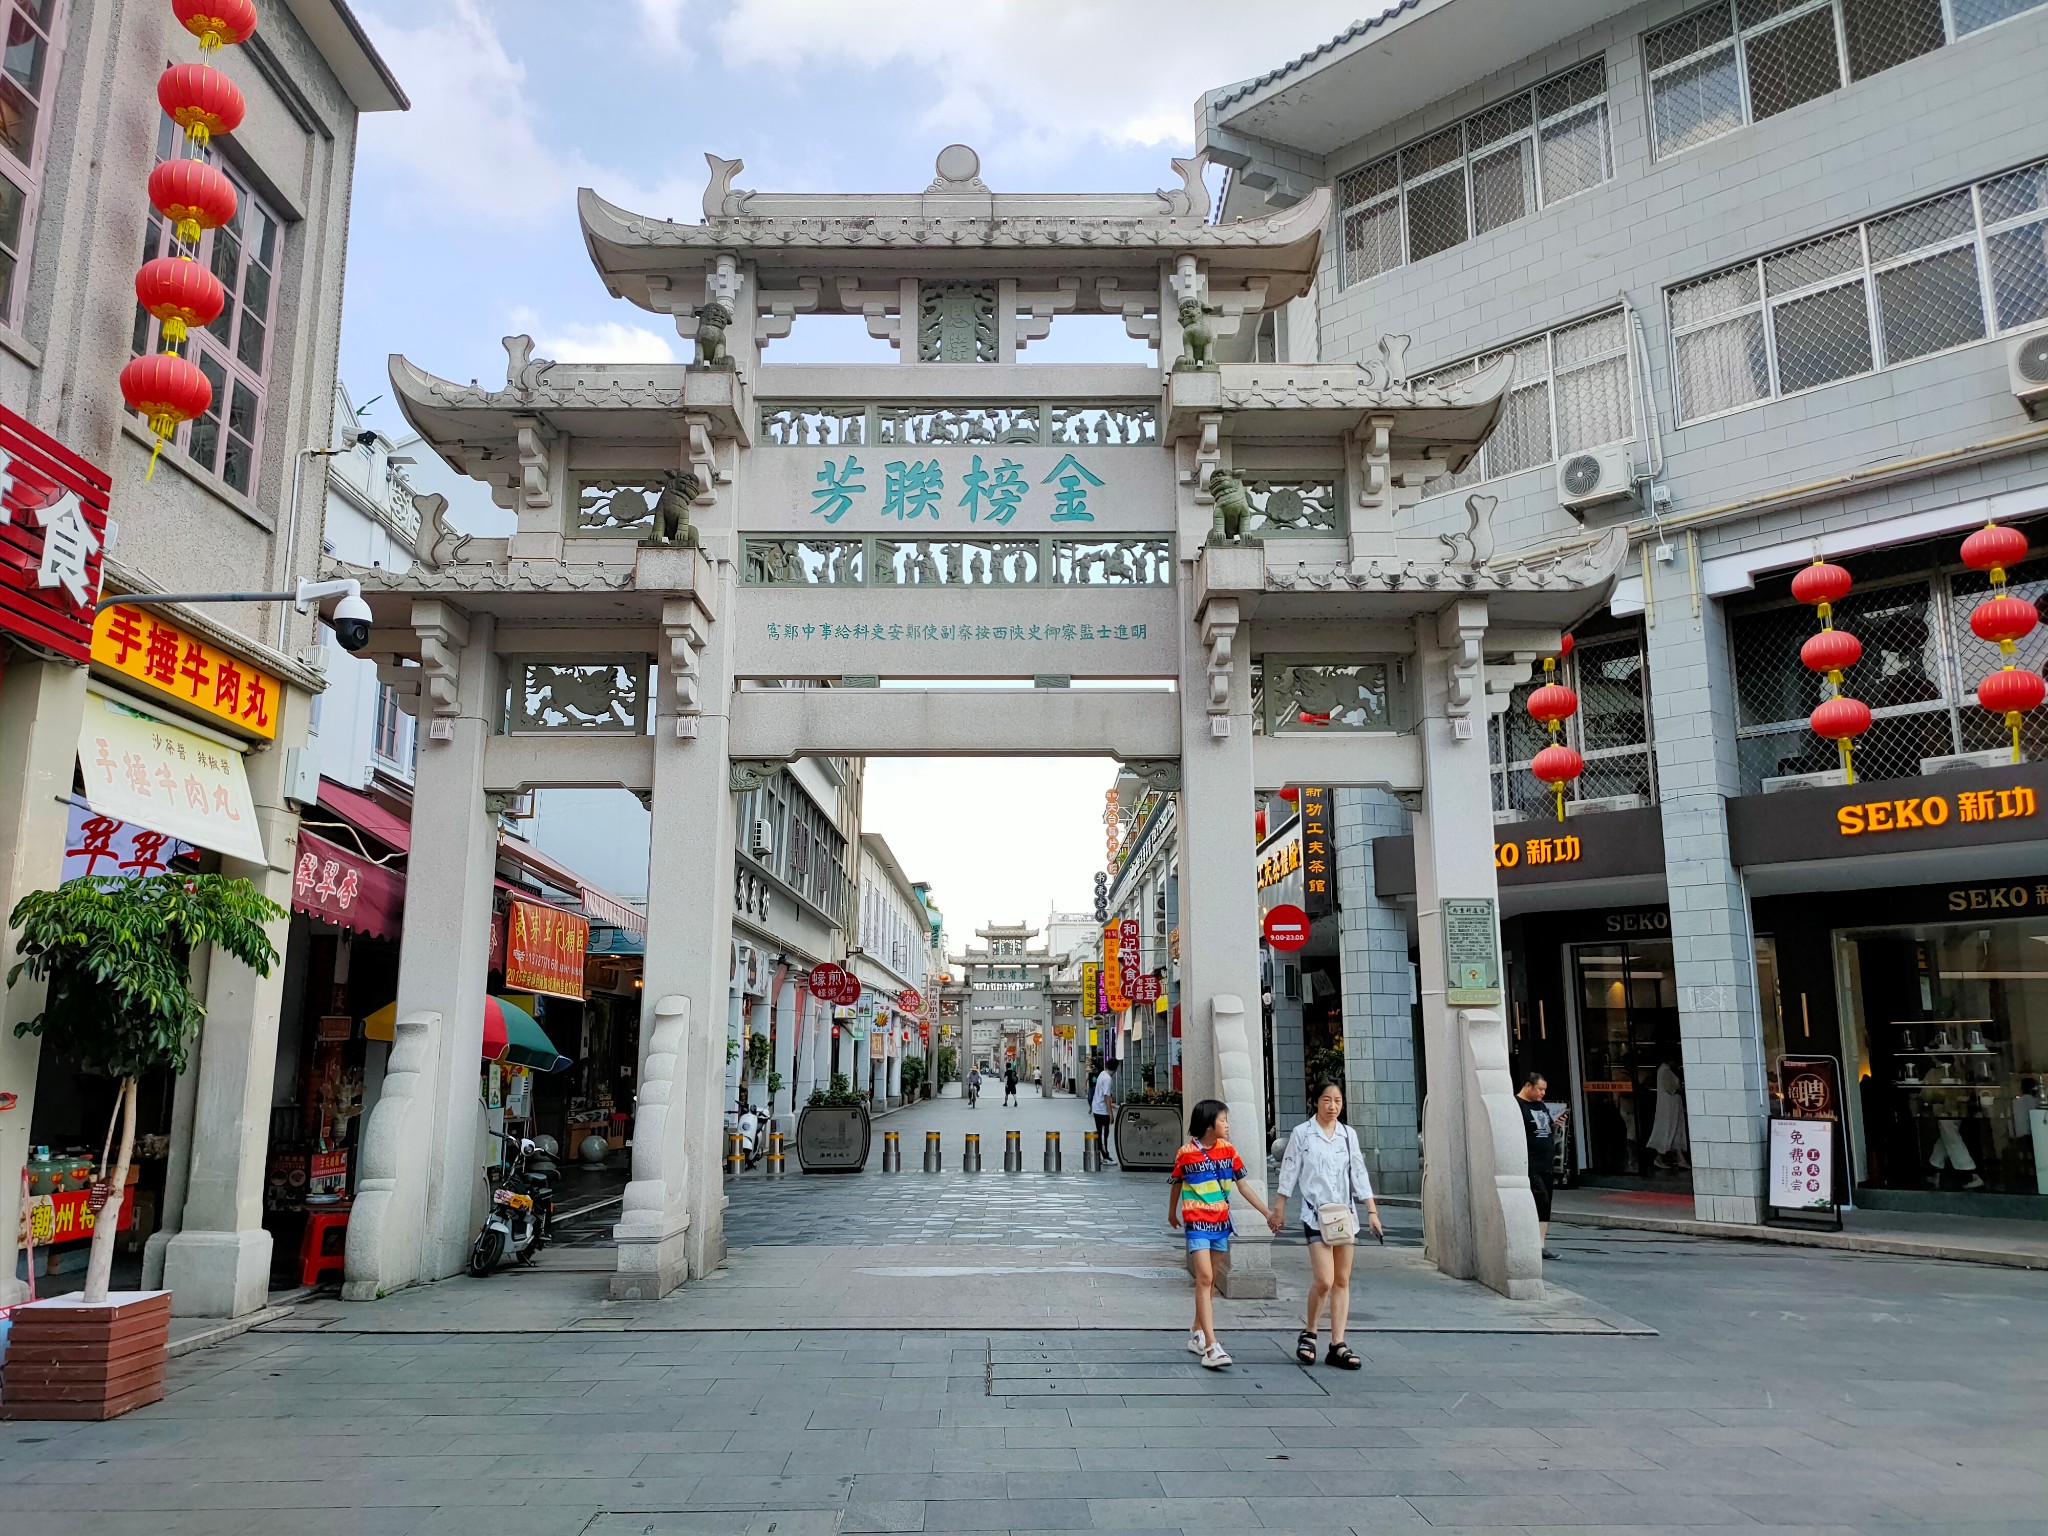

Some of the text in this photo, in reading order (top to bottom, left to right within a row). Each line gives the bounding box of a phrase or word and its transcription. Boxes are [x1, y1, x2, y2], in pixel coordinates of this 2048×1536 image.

[106, 604, 269, 728] 手捶牛肉丸
[95, 738, 241, 821] 手捶牛肉丸
[1837, 785, 2037, 835] SEKO 新功
[66, 813, 200, 877] 翠翠
[1526, 834, 1581, 865] 新功
[295, 852, 359, 909] 翠翠香
[1948, 886, 2029, 911] SEKO
[1606, 912, 1668, 932] SEKO
[1144, 977, 1158, 1002] 采耳
[1788, 1080, 1825, 1108] 招聘
[1789, 1129, 1805, 1192] 免费品尝
[1807, 1149, 1820, 1192] 工夫茶
